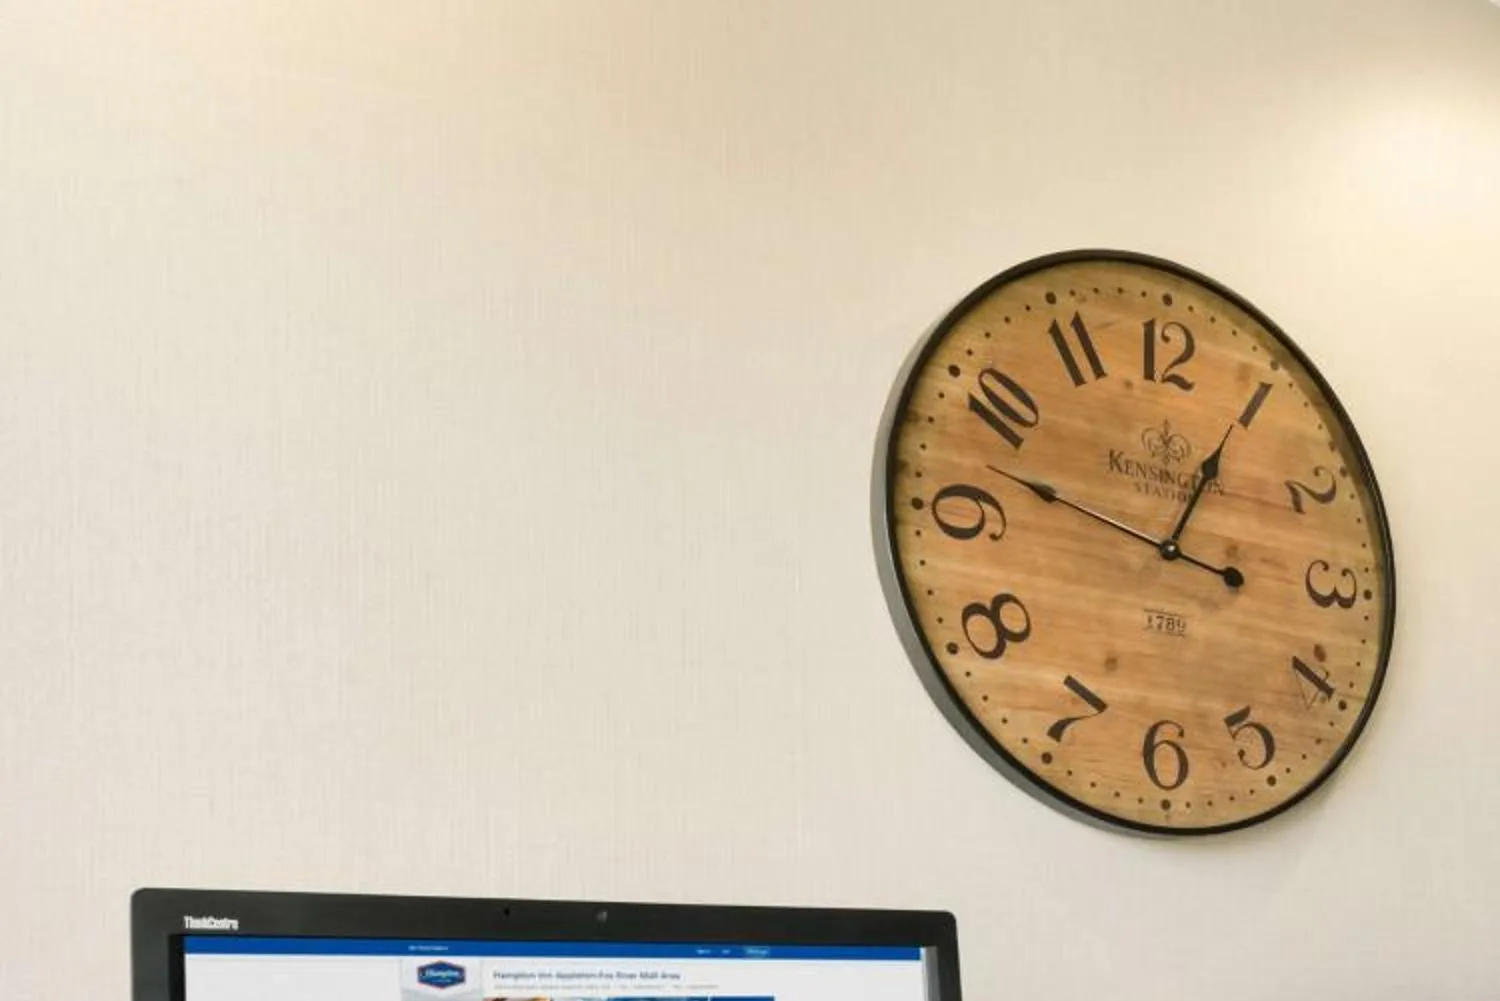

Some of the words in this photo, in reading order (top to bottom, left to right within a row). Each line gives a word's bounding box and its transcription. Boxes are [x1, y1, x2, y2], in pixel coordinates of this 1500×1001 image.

[1048, 310, 1108, 387] 11
[1142, 317, 1196, 392] 12
[968, 366, 1041, 451] 10
[1236, 382, 1274, 430] 1
[930, 483, 1007, 543] 9
[1283, 465, 1338, 516] 2
[1304, 558, 1359, 611] 3
[961, 591, 1032, 661] 8
[1046, 674, 1109, 743] 7
[1290, 654, 1339, 711] 4
[1142, 719, 1190, 792] 6
[1223, 704, 1277, 770] 5
